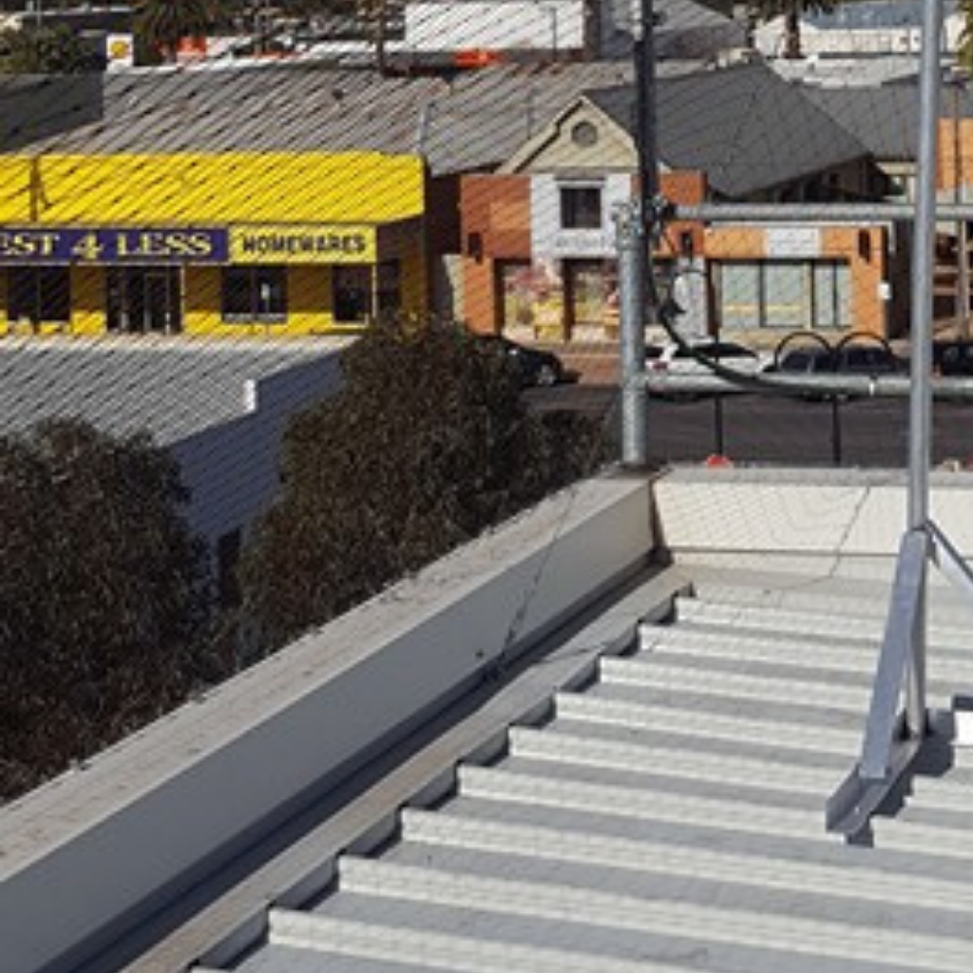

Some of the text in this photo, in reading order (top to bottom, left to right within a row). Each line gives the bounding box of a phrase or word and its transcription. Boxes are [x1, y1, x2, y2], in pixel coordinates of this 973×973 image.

[72, 233, 103, 259] 4
[116, 233, 212, 256] LESS
[242, 234, 367, 253] HOMEWARES
